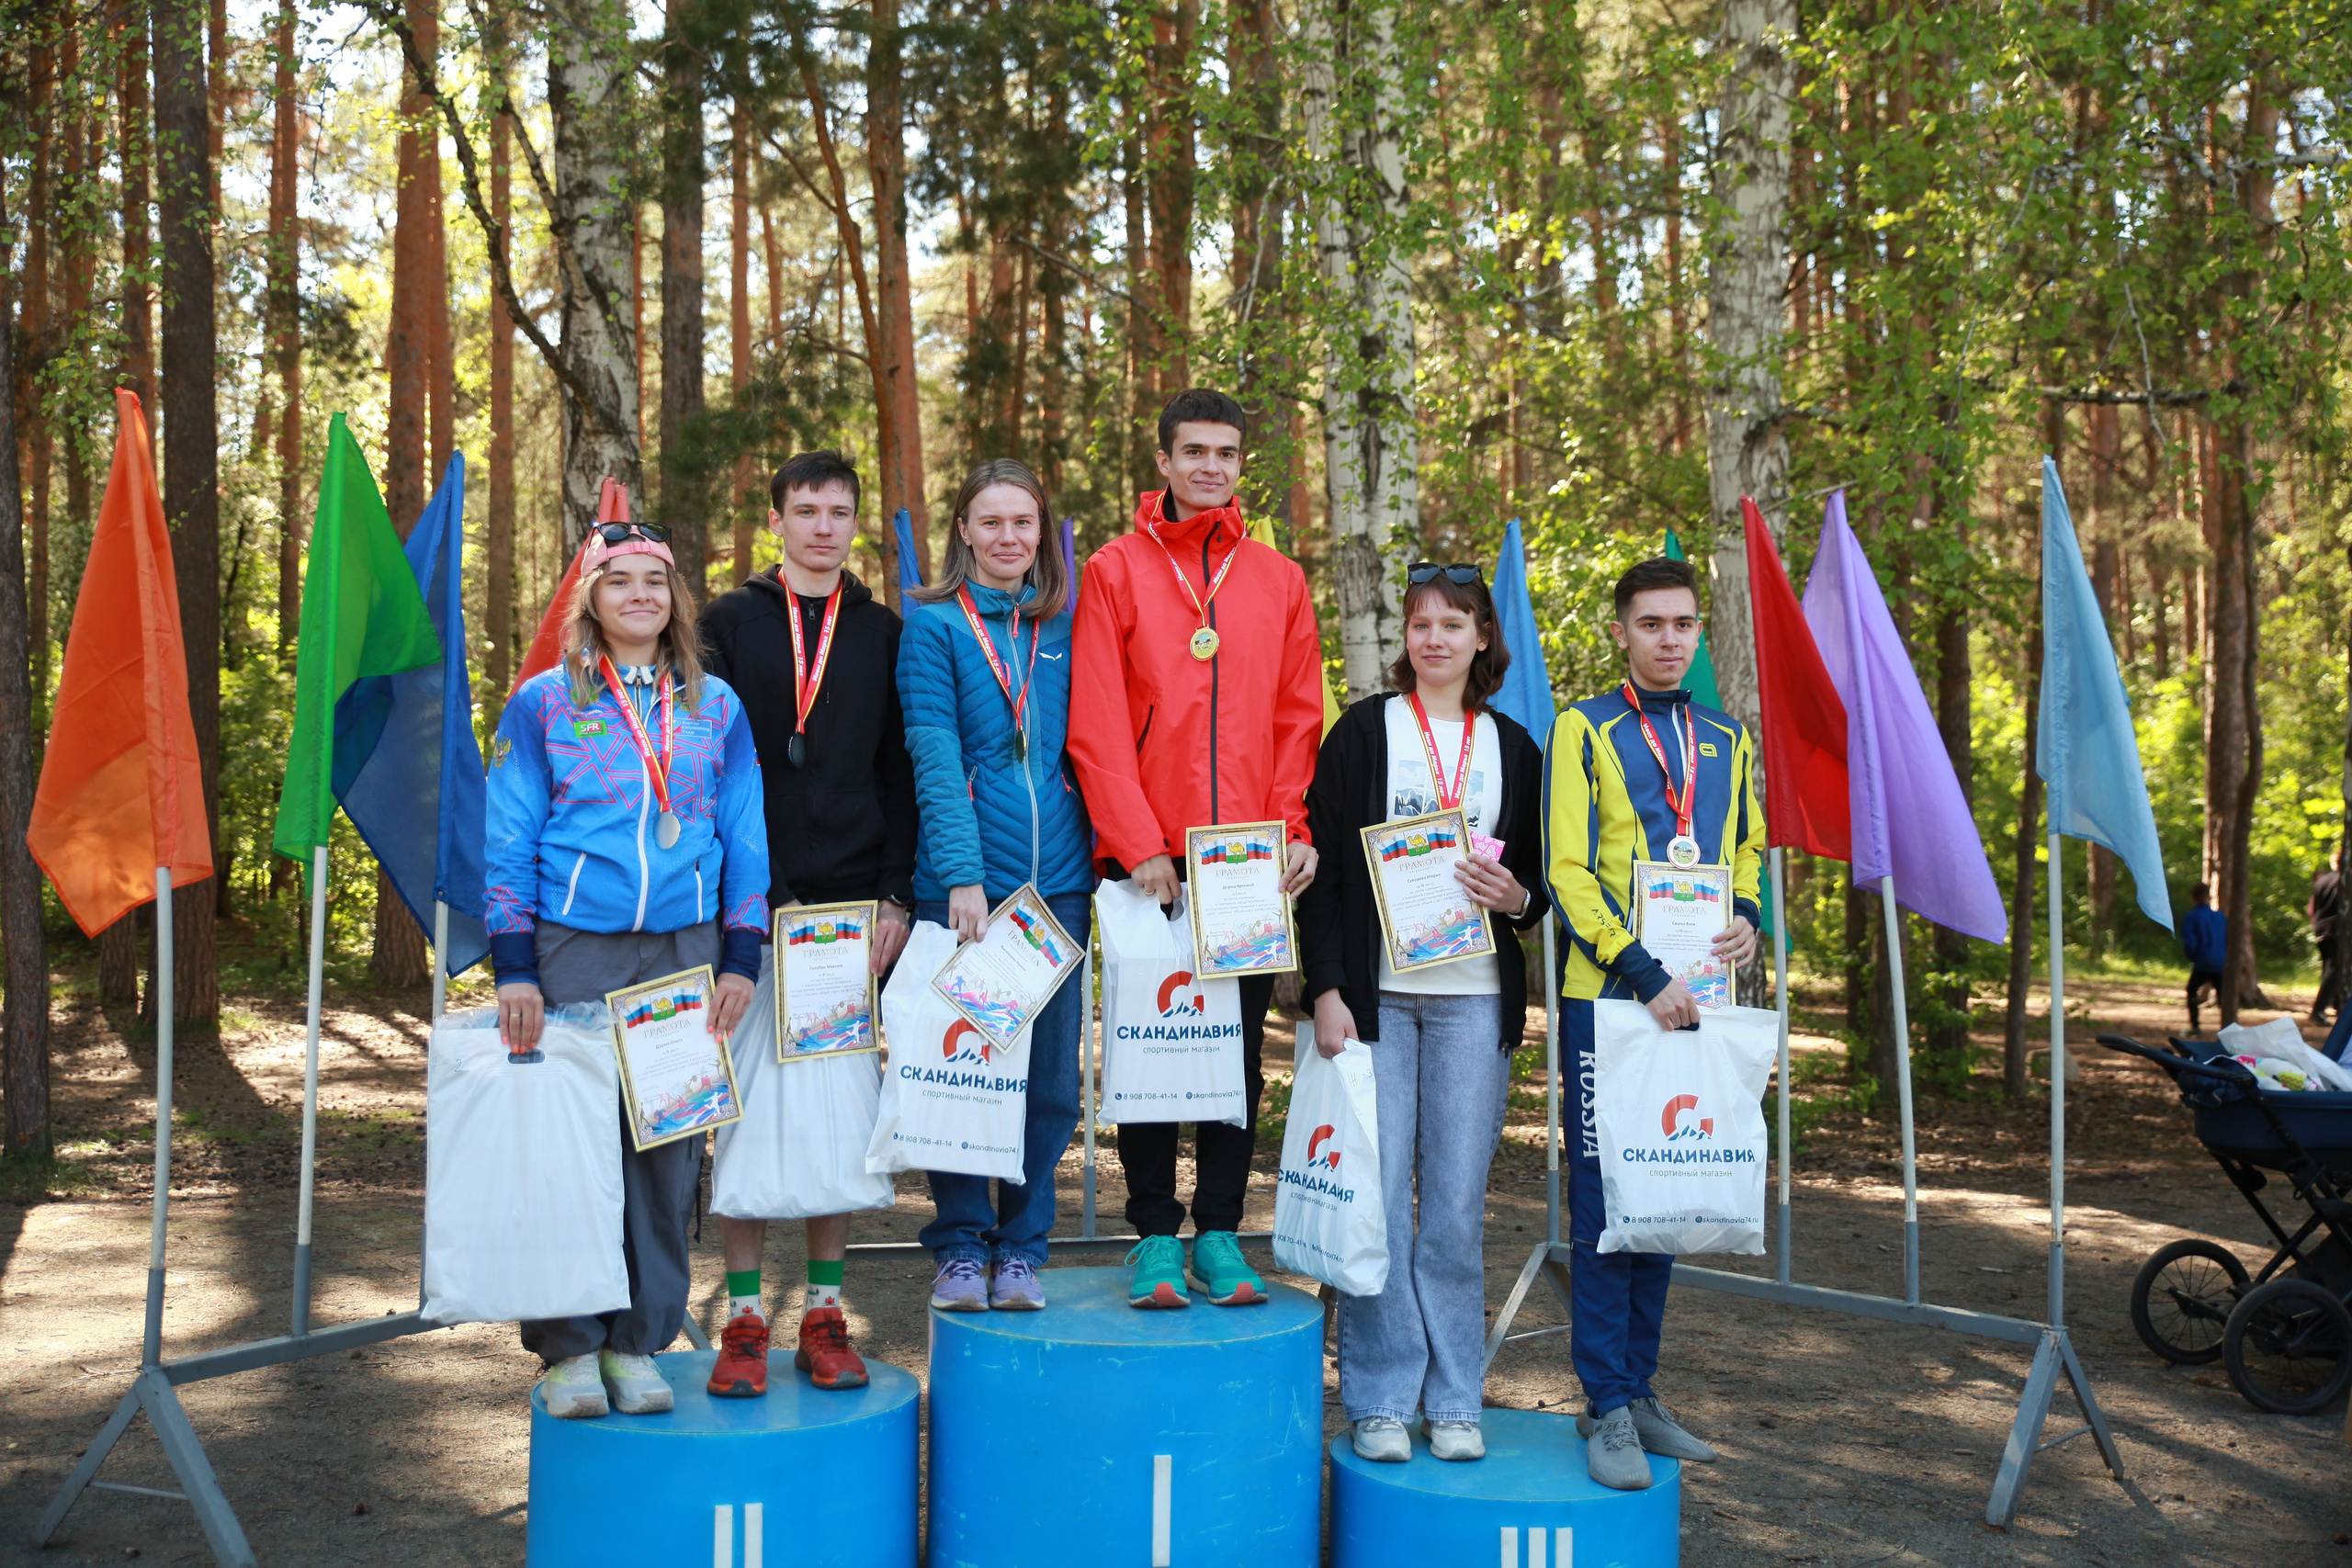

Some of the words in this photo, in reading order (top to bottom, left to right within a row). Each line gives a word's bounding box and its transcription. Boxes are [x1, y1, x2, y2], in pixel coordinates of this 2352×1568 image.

[793, 623, 799, 632] да
[970, 612, 981, 628] Иван
[981, 636, 994, 657] Марья
[794, 632, 802, 653] Марья
[819, 635, 829, 655] Марья
[817, 654, 824, 664] да
[811, 664, 820, 681] Иван
[616, 687, 625, 699] лет
[626, 707, 640, 729] Марья
[581, 722, 600, 733] SFR
[665, 725, 670, 734] да
[1642, 722, 1654, 739] Иван
[639, 739, 651, 757] Иван
[1423, 730, 1432, 746] Иван
[1430, 754, 1441, 775] Марья
[1459, 753, 1468, 773] Марья
[1457, 773, 1464, 782] да
[1453, 782, 1462, 798] Иван
[1216, 867, 1261, 877] ГРАМОТА
[1399, 856, 1445, 872] ГРАМОТА
[1663, 905, 1706, 915] ГРАМОТА
[803, 947, 849, 958] ГРАМОТА
[1008, 931, 1040, 966] ГРАМОТА
[644, 1019, 691, 1038] ГРАМОТА
[1116, 1023, 1241, 1041] СКАНДИНАВИЯ
[1143, 1045, 1189, 1055] спортивный
[900, 1065, 1028, 1093] СКАНДИНАВИЯ
[922, 1089, 971, 1101] спортивный
[972, 1095, 1002, 1105] магазин
[919, 1137, 952, 1147] 708-41-14
[1623, 1148, 1755, 1164] СКАНДИНАВИЯ
[1649, 1169, 1698, 1178] спортивный
